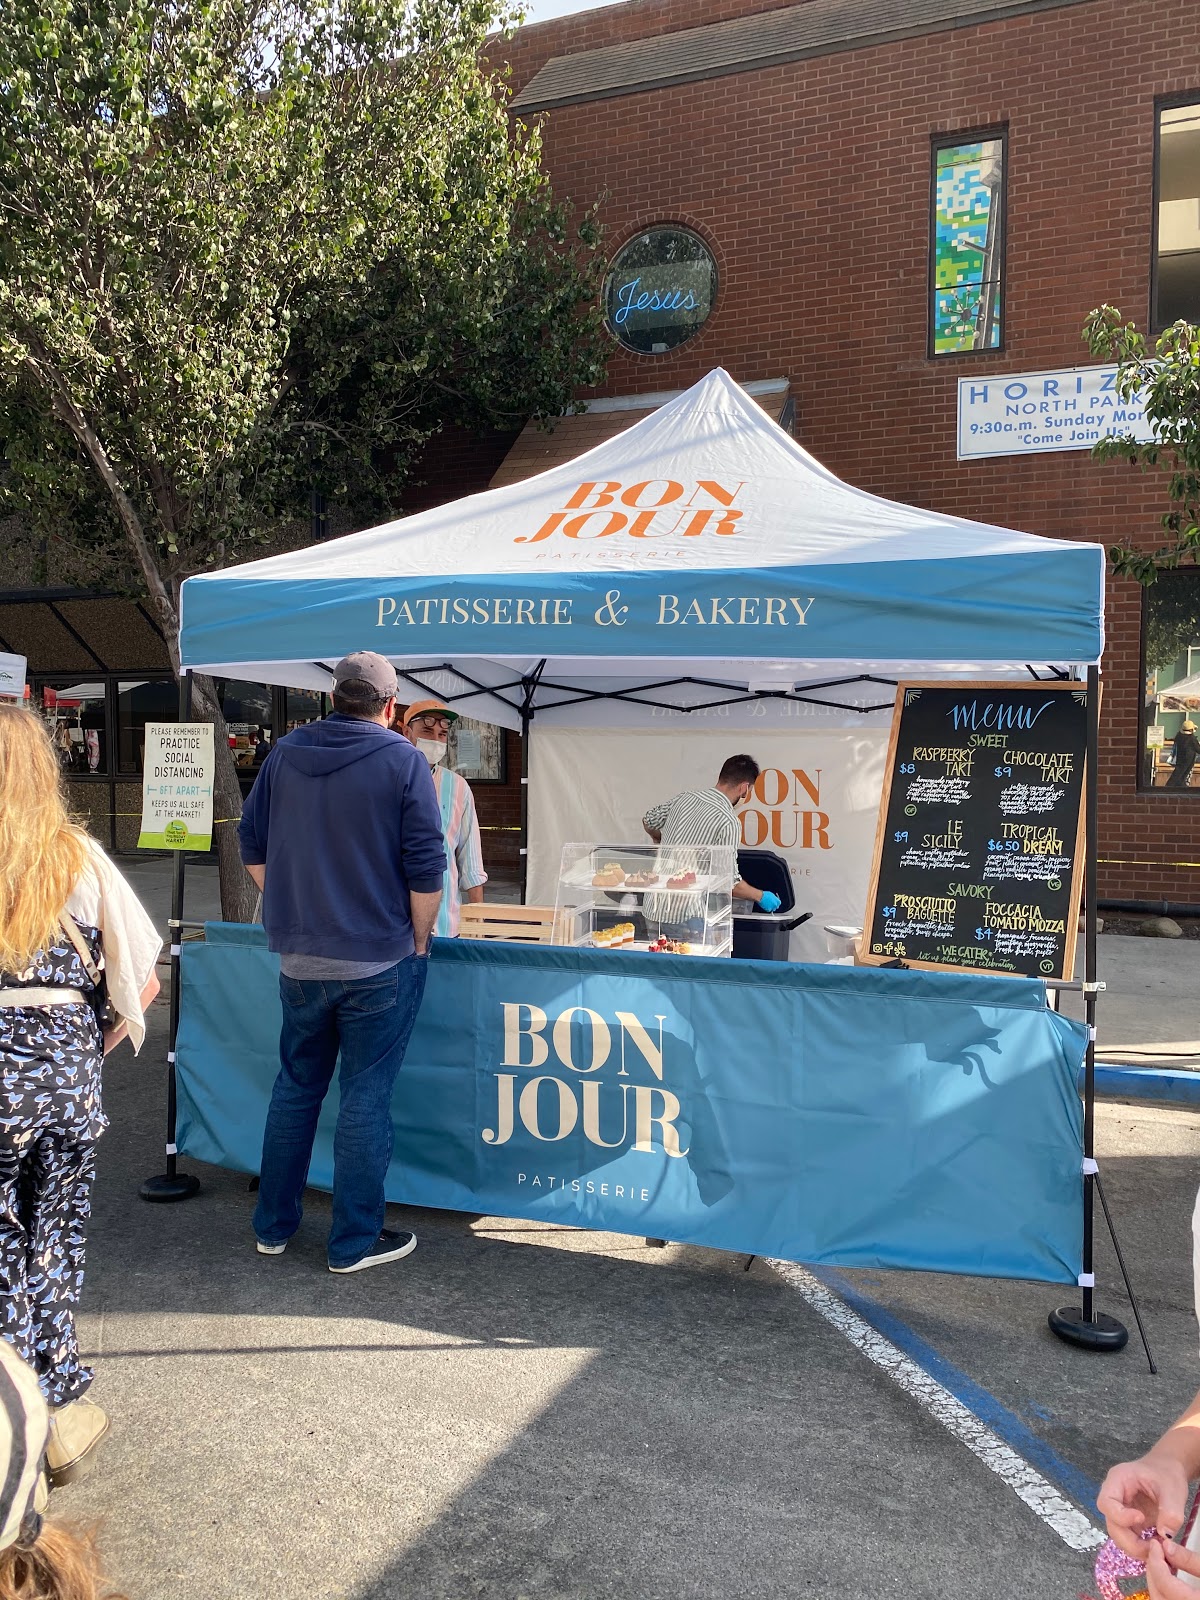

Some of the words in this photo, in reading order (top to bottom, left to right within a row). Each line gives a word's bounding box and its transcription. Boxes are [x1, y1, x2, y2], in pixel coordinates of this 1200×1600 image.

[615, 277, 700, 324] Jesus
[970, 373, 1130, 405] HORIZ
[1005, 399, 1077, 417] NORTH
[1089, 392, 1143, 409] PARK
[969, 420, 1037, 435] 9:30a.m.
[1044, 412, 1105, 429] Sunday
[1112, 409, 1145, 423] Mor
[1017, 432, 1063, 445] "Come
[1069, 429, 1099, 442] Join
[1106, 425, 1130, 438] Us"
[560, 480, 749, 510] BON
[513, 509, 745, 544] JOUR
[535, 550, 687, 560] PATISSERIE
[375, 597, 573, 628] PATISSERIE
[594, 589, 629, 627] &
[656, 594, 816, 627] BAKERY
[151, 727, 172, 736] PLEASE
[173, 727, 201, 736] REMEMBER
[202, 728, 209, 736] TO
[160, 738, 201, 749] PRACTICE
[967, 734, 1009, 748] SWEET
[164, 752, 195, 764] SOCIAL
[912, 746, 977, 762] RASPBERRY
[1003, 750, 1074, 768] CHOCOLATE
[154, 766, 204, 779] DISTANCING
[899, 762, 916, 774] $8
[945, 761, 976, 777] TART
[994, 766, 1012, 778] $9
[1040, 766, 1074, 784] TART
[159, 785, 173, 795] 6FT
[175, 785, 201, 796] APART
[745, 768, 822, 807] ON
[151, 800, 169, 808] KEEPS
[169, 800, 177, 808] US
[178, 801, 189, 809] ALL
[190, 801, 205, 809] SAFE
[154, 809, 163, 817] AT
[164, 810, 174, 818] THE
[175, 810, 201, 819] MARKET!
[737, 809, 835, 850] OUR
[947, 819, 964, 835] LE
[1000, 822, 1061, 842] TROPICAL
[893, 830, 909, 843] $9
[920, 833, 963, 850] SICILY
[1023, 839, 1064, 856] DREAM
[946, 883, 996, 899] SAVORY
[893, 893, 957, 912] PROSCIUTTO
[985, 902, 1043, 920] FOCCACIA
[882, 905, 897, 919] $9
[906, 907, 956, 924] BAGUETTE
[974, 926, 994, 941] $4
[982, 915, 1027, 931] TOMATO
[1027, 918, 1066, 934] MOZZA
[941, 944, 957, 956] WE
[957, 946, 988, 960] CATER
[500, 1002, 667, 1081] BON
[481, 1073, 690, 1158] JOUR
[518, 1173, 649, 1202] PATISSERIE
